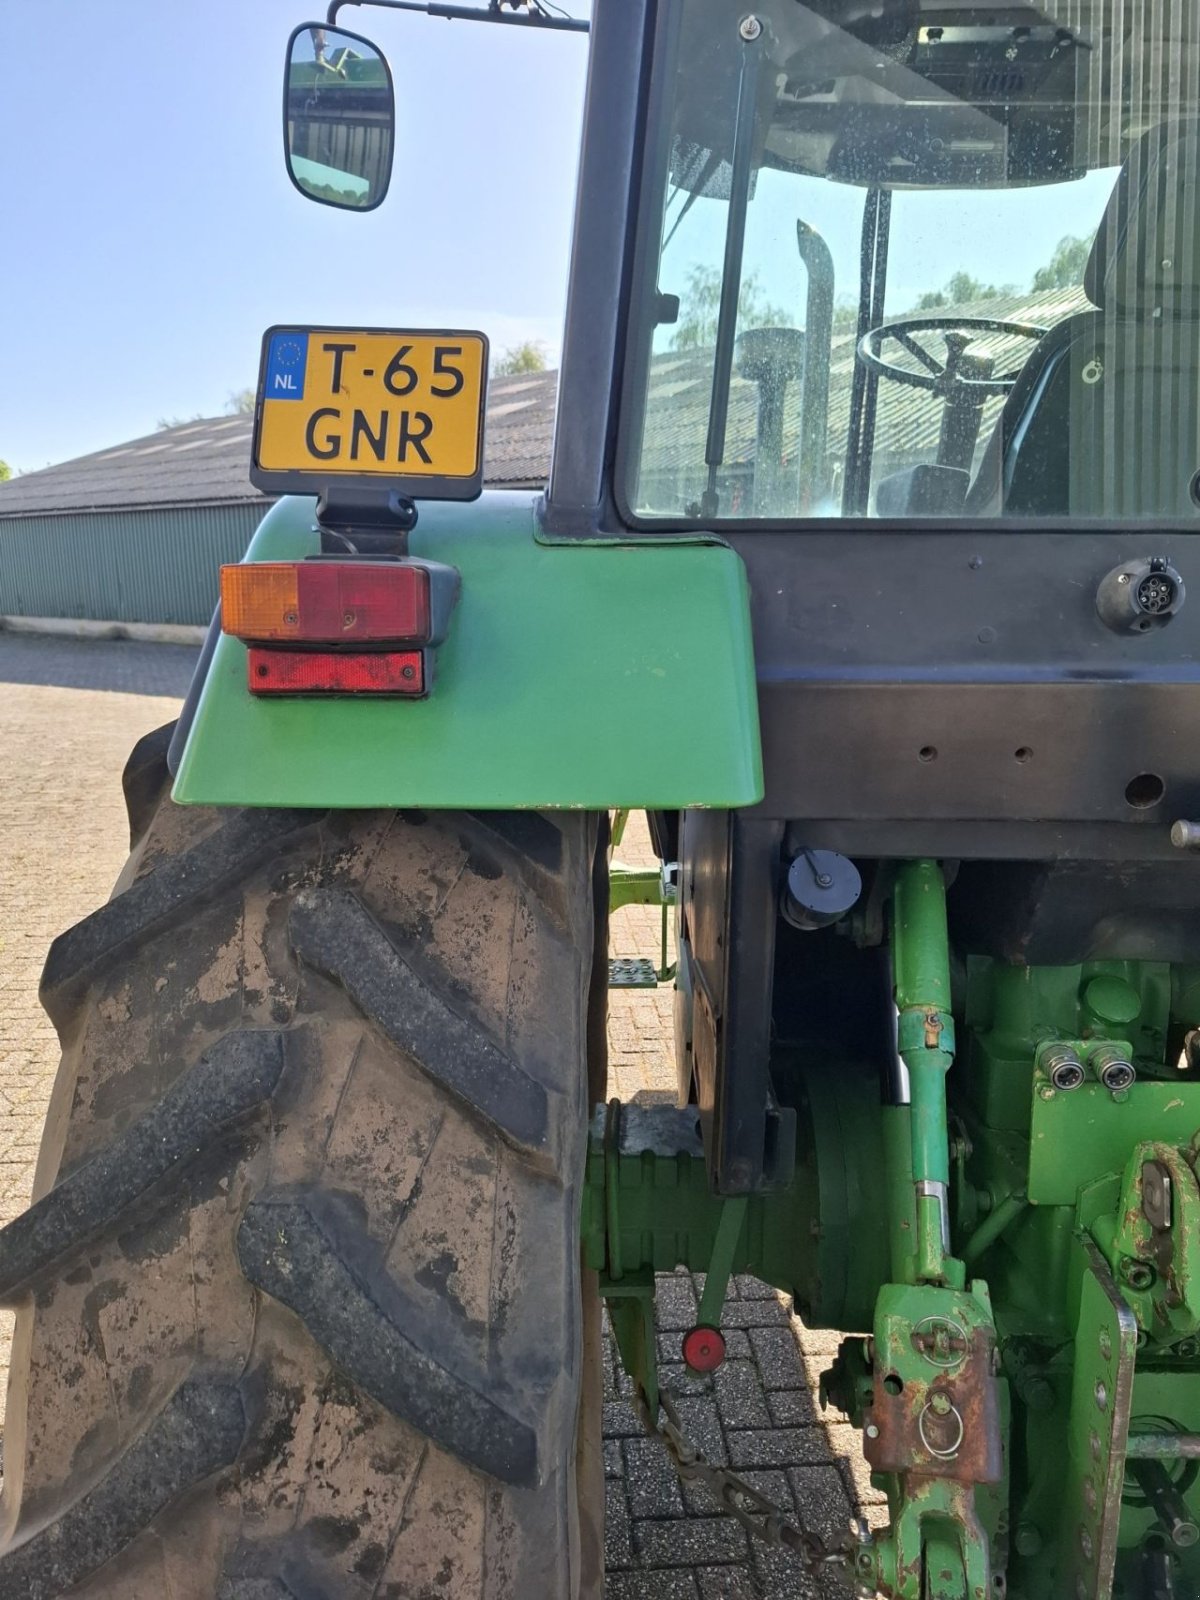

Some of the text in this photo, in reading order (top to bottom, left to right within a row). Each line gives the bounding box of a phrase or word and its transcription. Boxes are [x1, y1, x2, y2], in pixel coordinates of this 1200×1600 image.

[274, 374, 297, 390] NL
[322, 343, 465, 398] T-65
[305, 407, 433, 464] GNR
